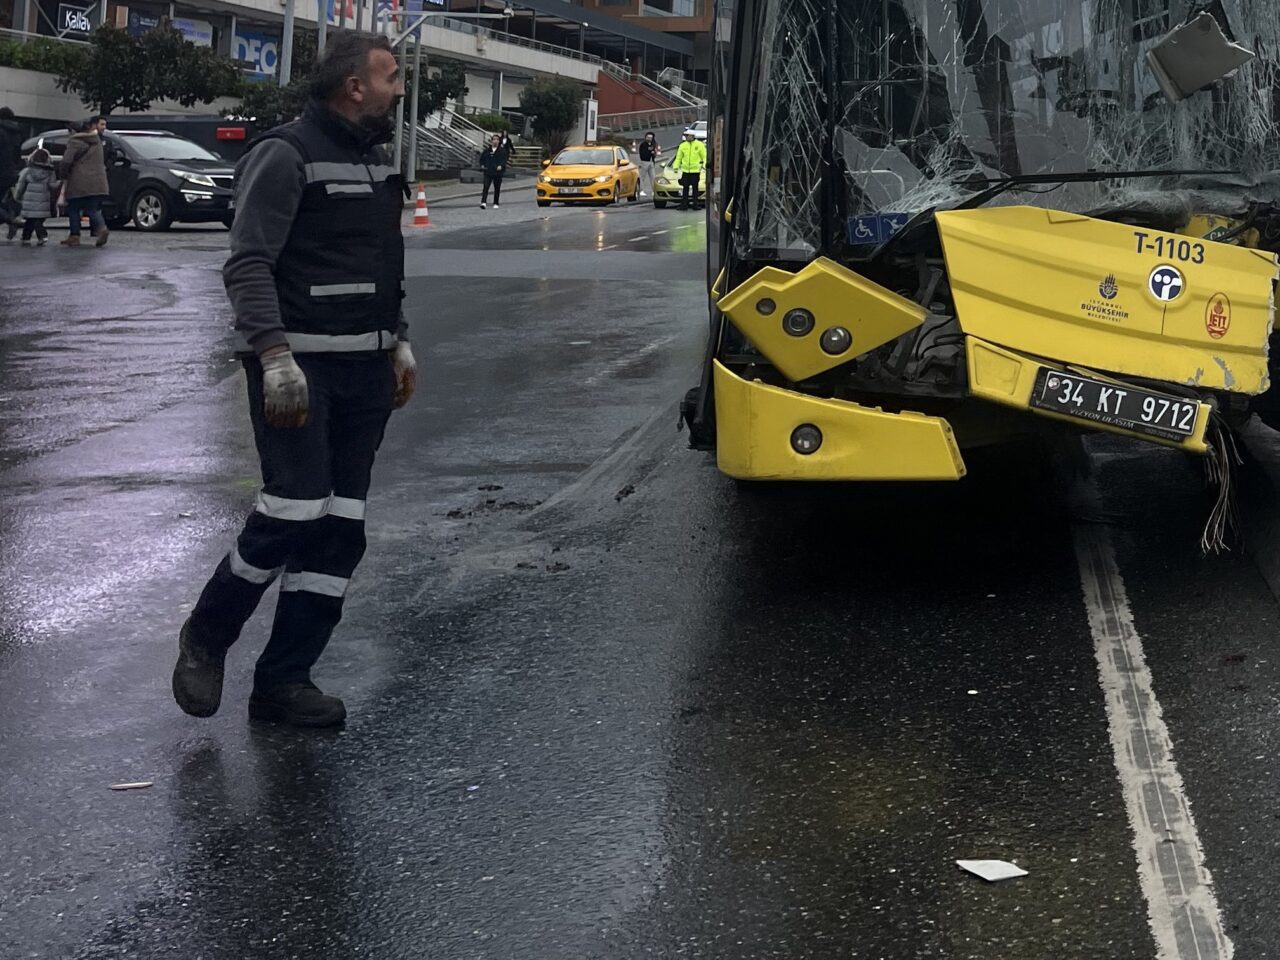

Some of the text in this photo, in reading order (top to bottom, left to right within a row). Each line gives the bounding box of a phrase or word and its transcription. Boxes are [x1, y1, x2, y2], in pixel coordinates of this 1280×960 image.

[1133, 231, 1205, 264] T-1103
[1057, 379, 1194, 430] 34 KT 9712
